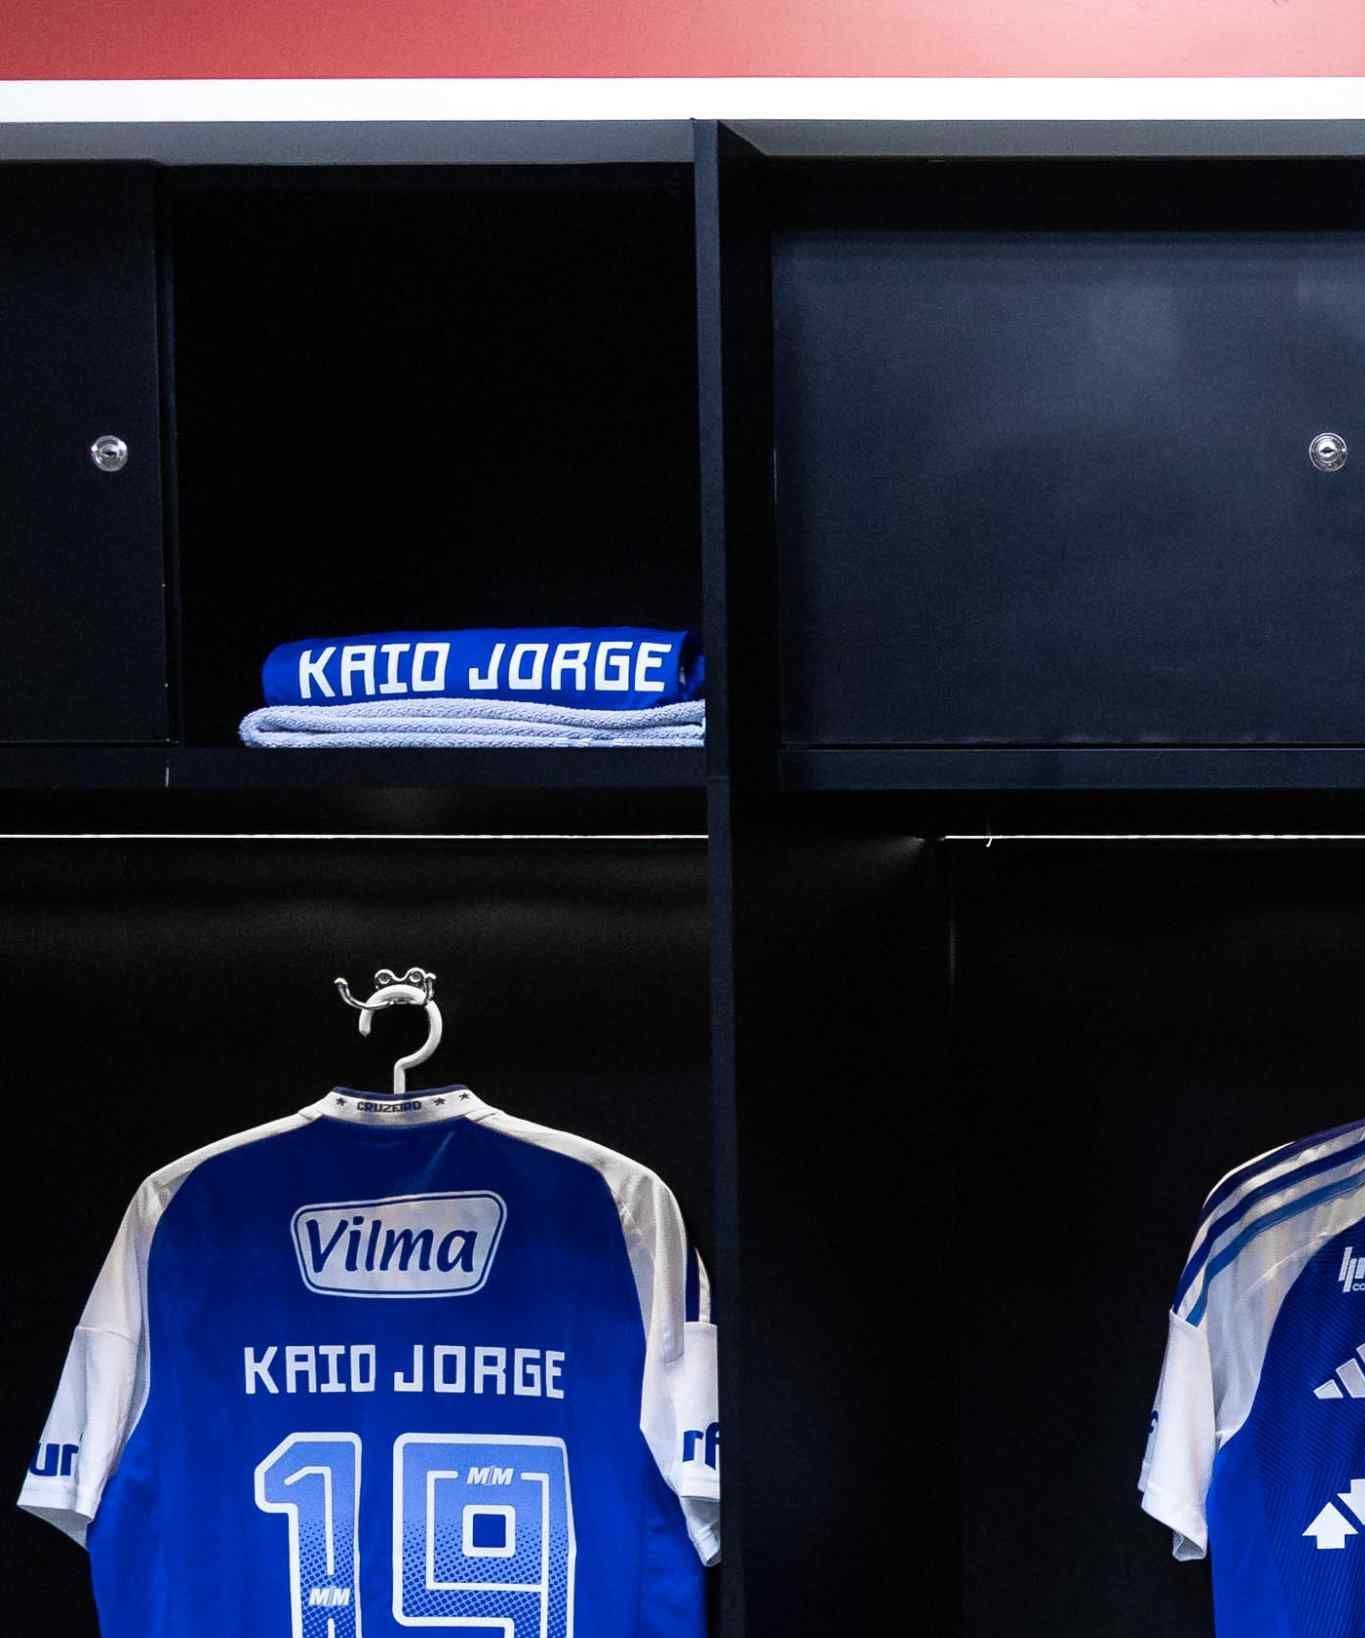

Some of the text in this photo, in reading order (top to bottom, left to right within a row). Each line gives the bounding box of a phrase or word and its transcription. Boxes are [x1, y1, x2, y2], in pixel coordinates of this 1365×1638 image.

[300, 642, 672, 699] KAIO JORGE
[357, 1101, 422, 1112] CRUZEIRO
[305, 1216, 479, 1274] Vilma
[243, 1344, 565, 1399] KAIO JORGE
